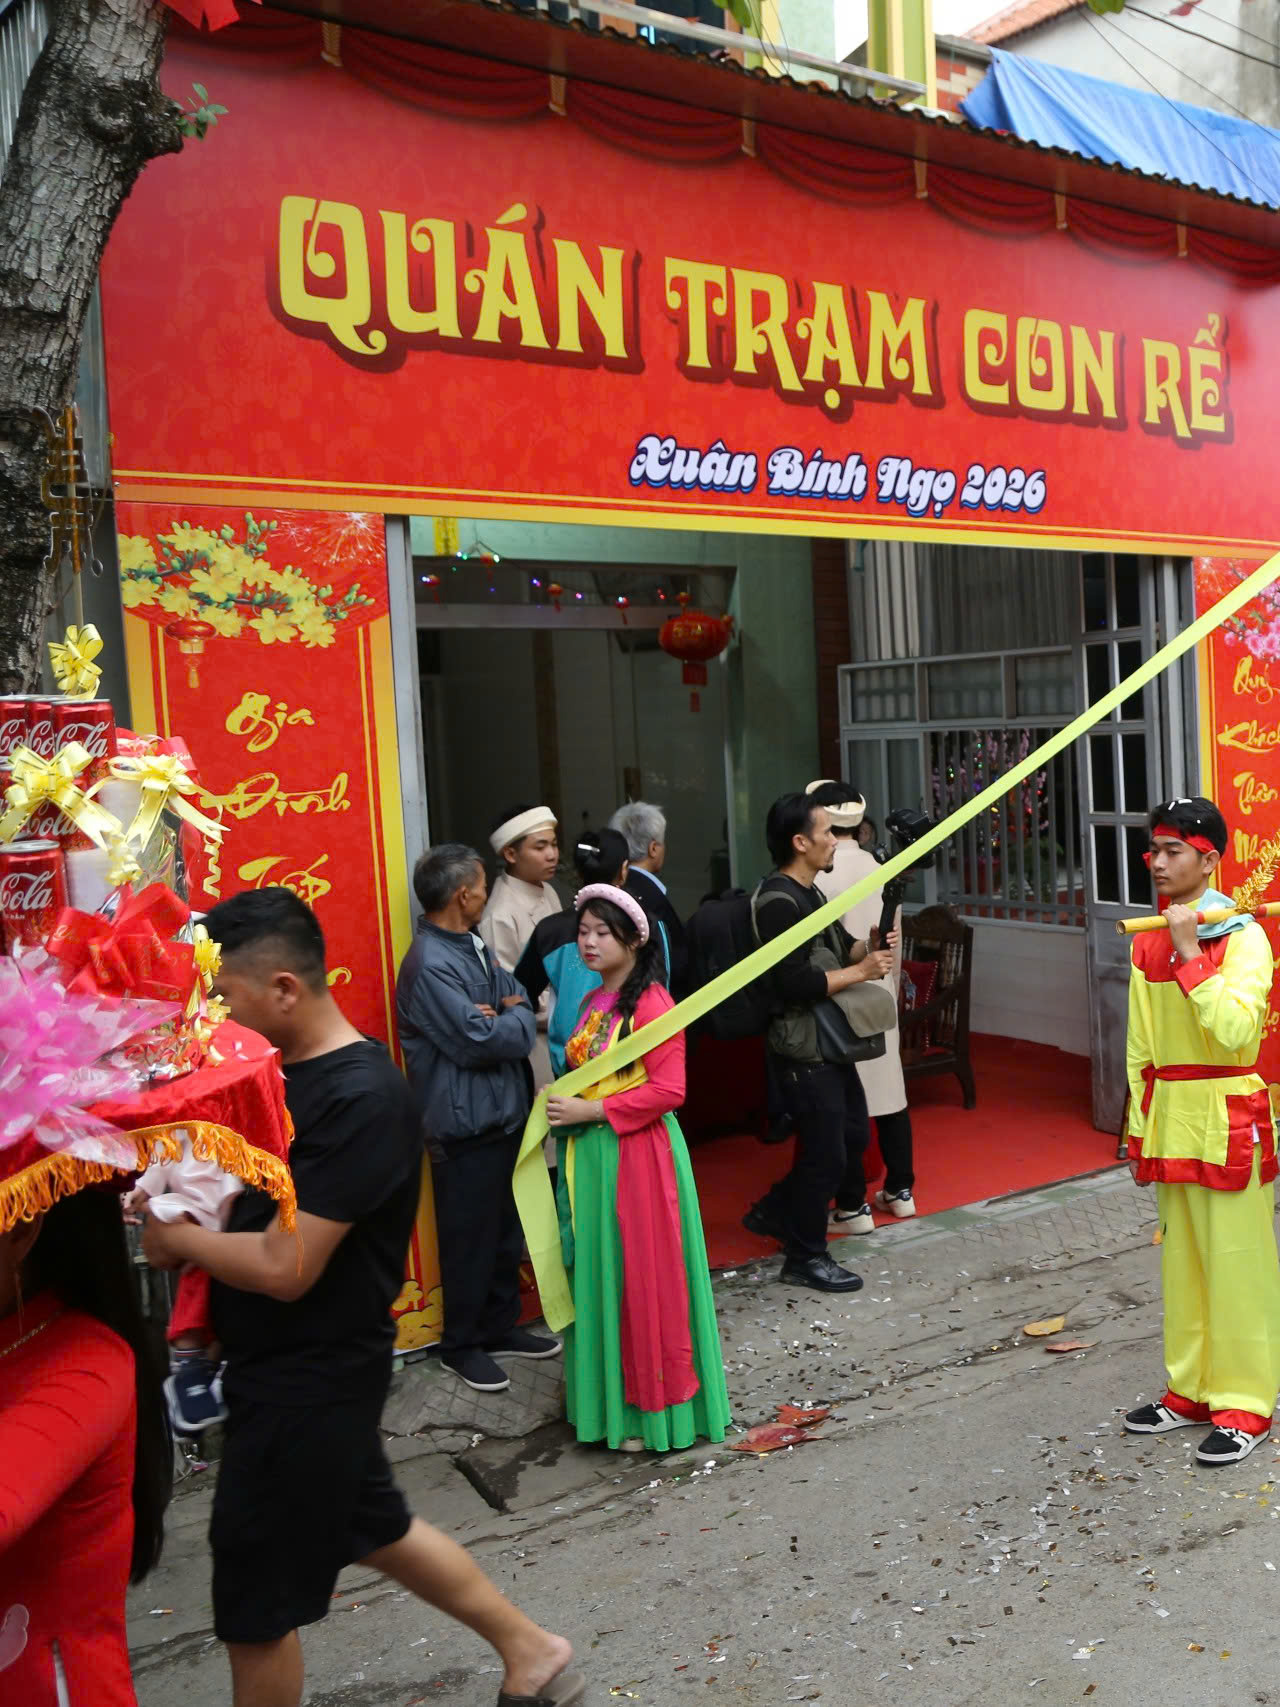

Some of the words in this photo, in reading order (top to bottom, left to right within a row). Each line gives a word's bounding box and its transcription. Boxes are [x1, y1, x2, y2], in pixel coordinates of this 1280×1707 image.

[279, 195, 628, 358] QUÁN
[664, 256, 932, 409] TRẠM
[963, 307, 1117, 419] CON
[1141, 313, 1226, 438] RỂ
[630, 433, 757, 489] Xuân
[767, 447, 869, 500] Bính
[876, 455, 957, 518] Ngọ
[961, 463, 1047, 513] 2026
